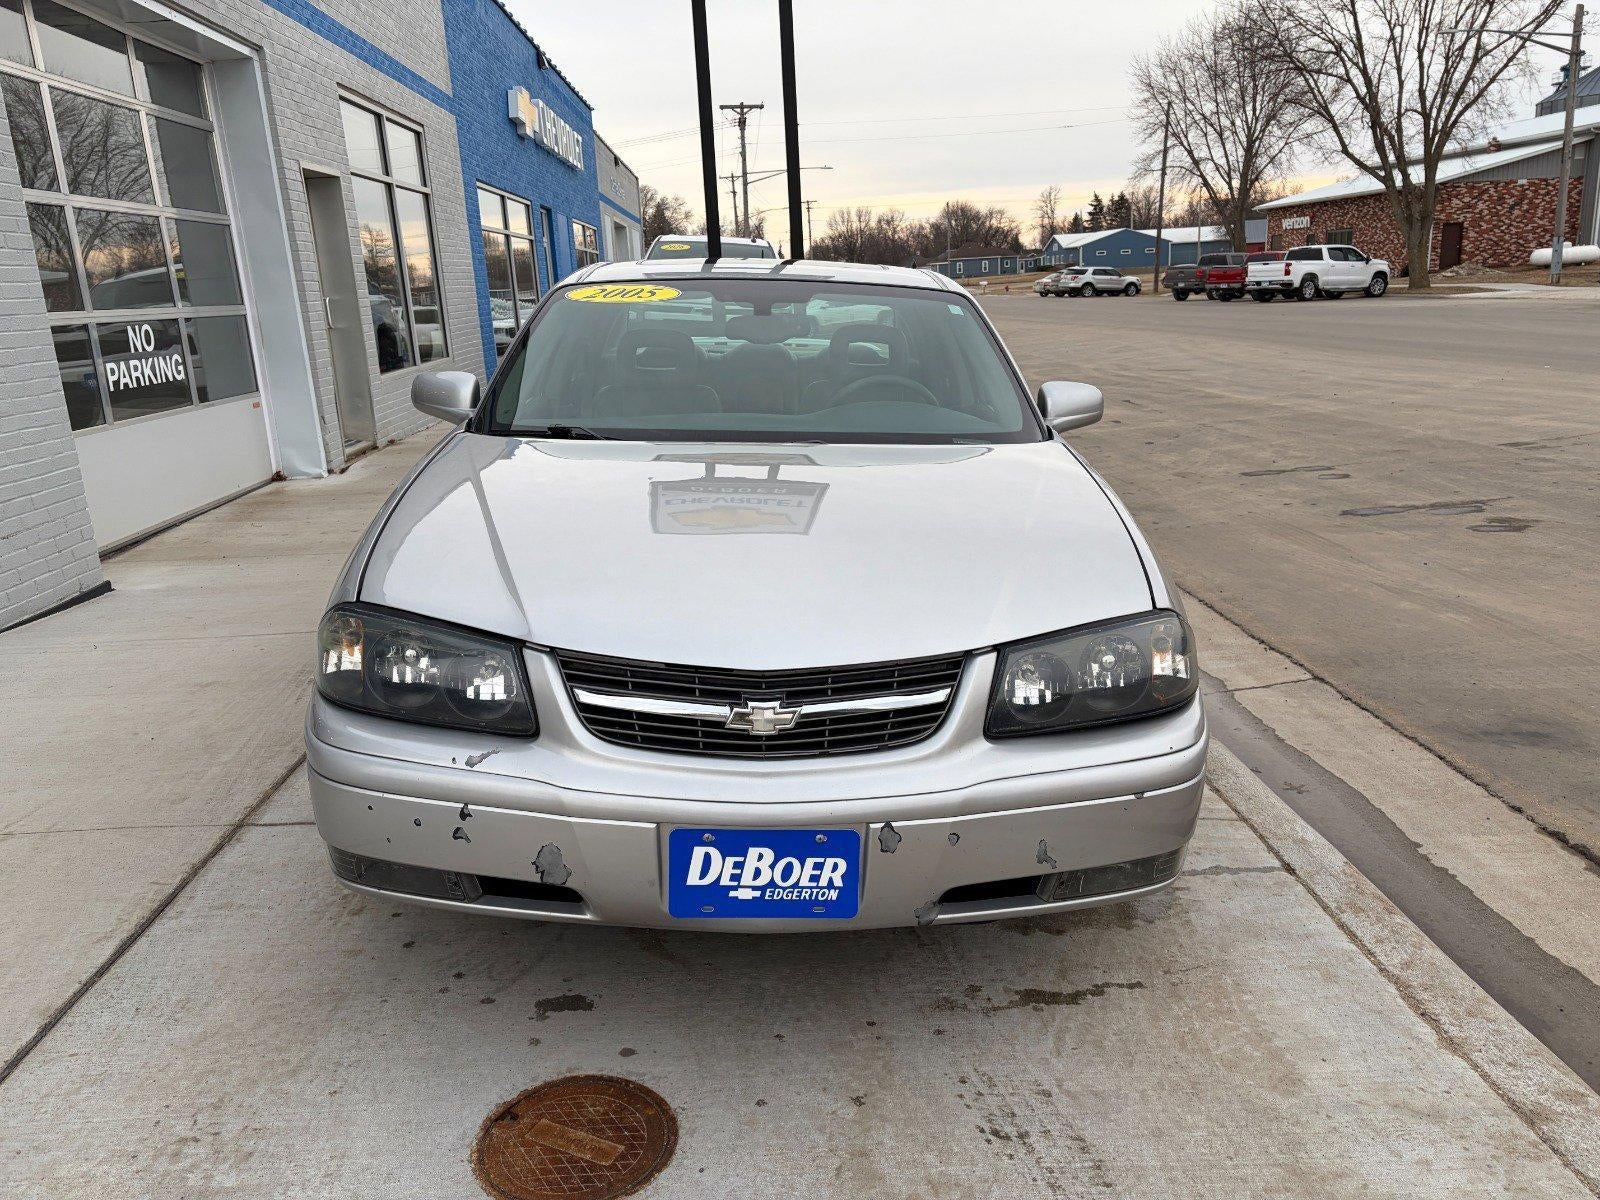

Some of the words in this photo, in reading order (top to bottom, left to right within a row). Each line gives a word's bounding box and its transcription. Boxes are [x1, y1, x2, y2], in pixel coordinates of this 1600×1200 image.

[538, 99, 584, 171] CHEVROLET
[1282, 214, 1311, 230] verizon
[583, 288, 663, 299] 2005
[126, 324, 155, 353] NO
[105, 354, 185, 391] PARKING
[764, 888, 840, 901] EDGERTON
